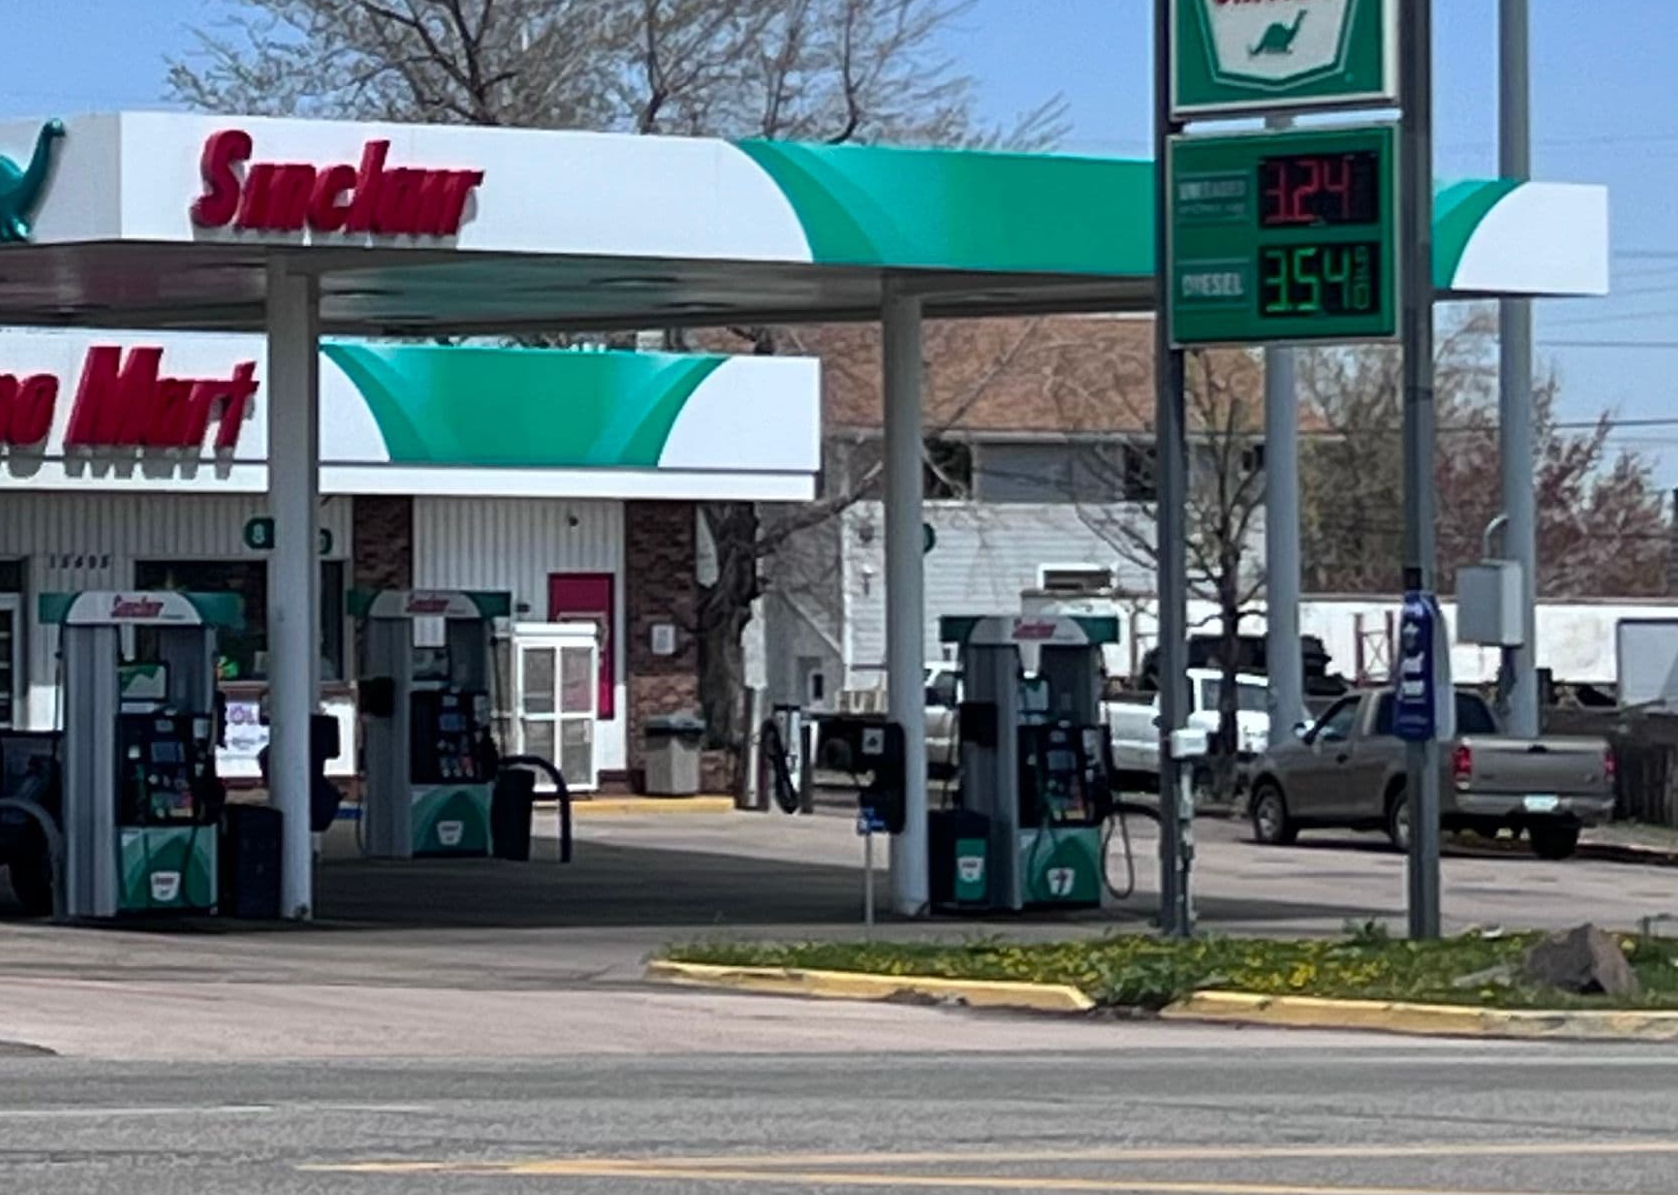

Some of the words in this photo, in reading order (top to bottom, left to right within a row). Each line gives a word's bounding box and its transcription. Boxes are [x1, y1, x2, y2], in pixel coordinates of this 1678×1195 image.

[189, 129, 486, 237] Sinclair
[1181, 272, 1244, 298] DIESEL
[62, 345, 261, 450] Mart
